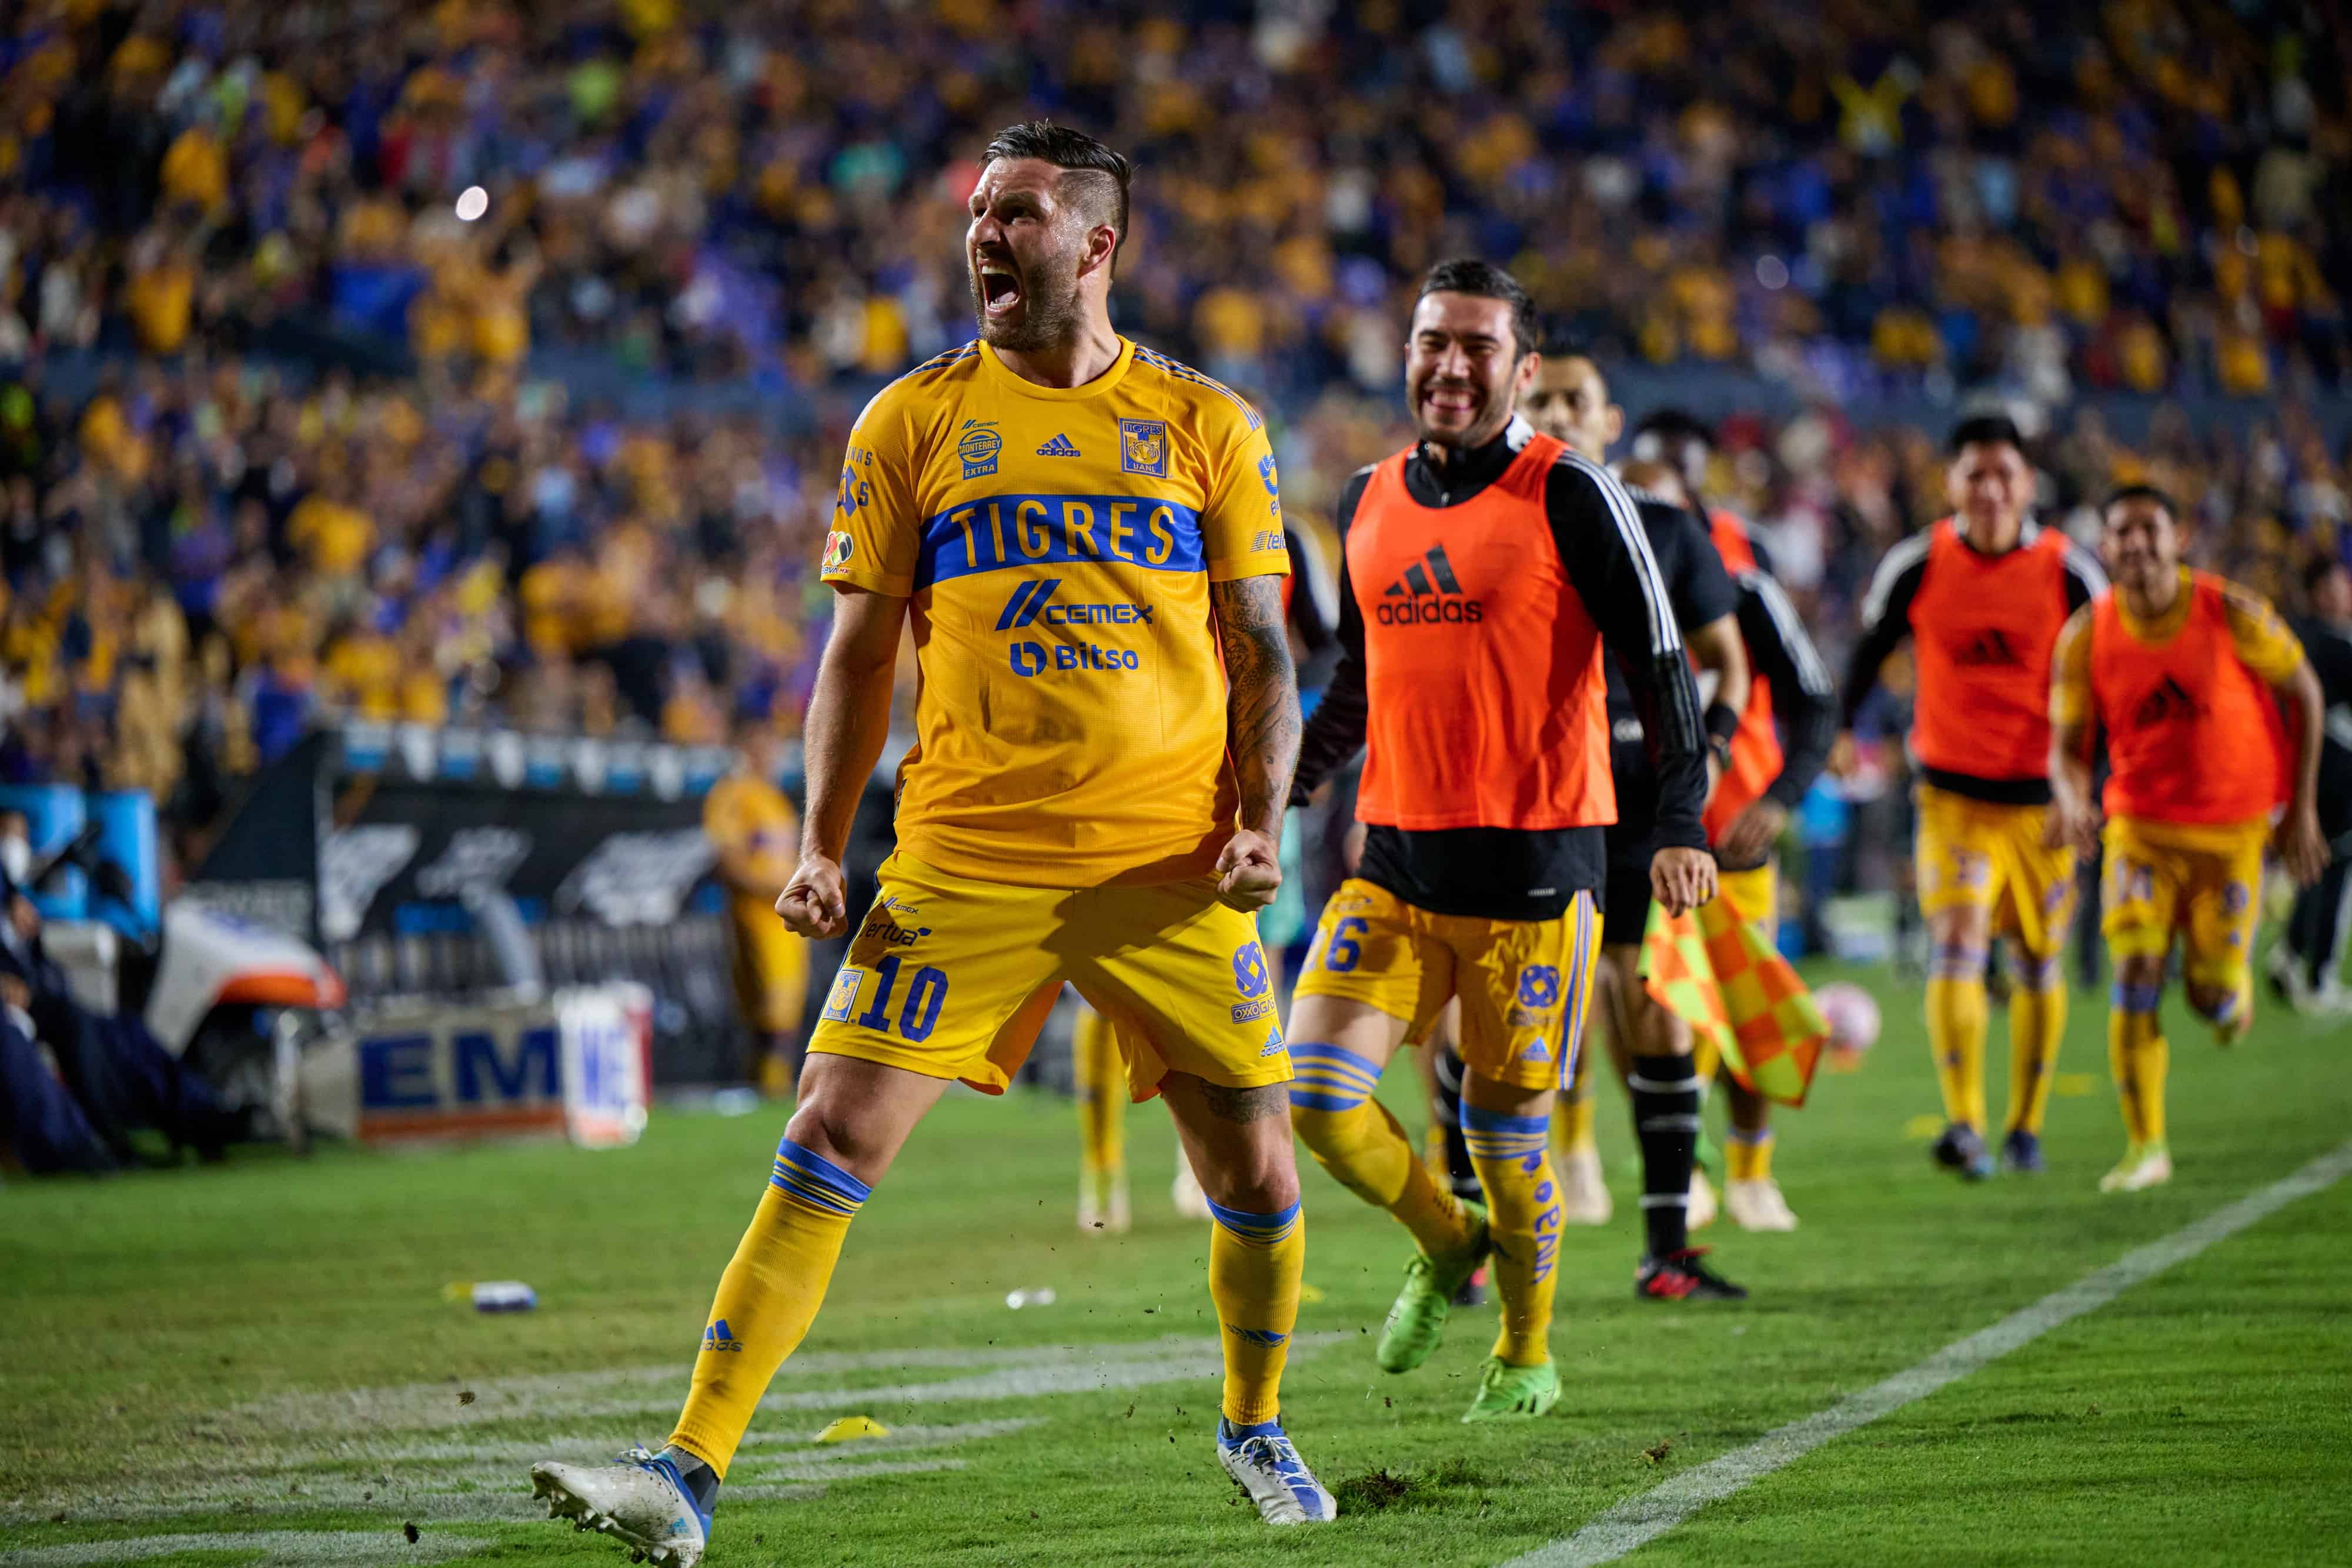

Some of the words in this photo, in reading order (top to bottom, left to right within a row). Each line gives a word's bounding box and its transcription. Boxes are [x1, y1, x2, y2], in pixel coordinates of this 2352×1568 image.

[1124, 423, 1162, 435] TIGRES
[959, 439, 1001, 454] MONTERREY
[1035, 447, 1081, 457] adidas
[965, 464, 995, 477] EXTRA
[1133, 463, 1156, 473] UANL
[951, 500, 1175, 568] TIGRES
[1045, 604, 1153, 625] CEMEX
[1378, 594, 1483, 626] adidas
[1055, 641, 1139, 670] Bitso
[858, 954, 949, 1043] 10
[1234, 1004, 1259, 1019] OXXO
